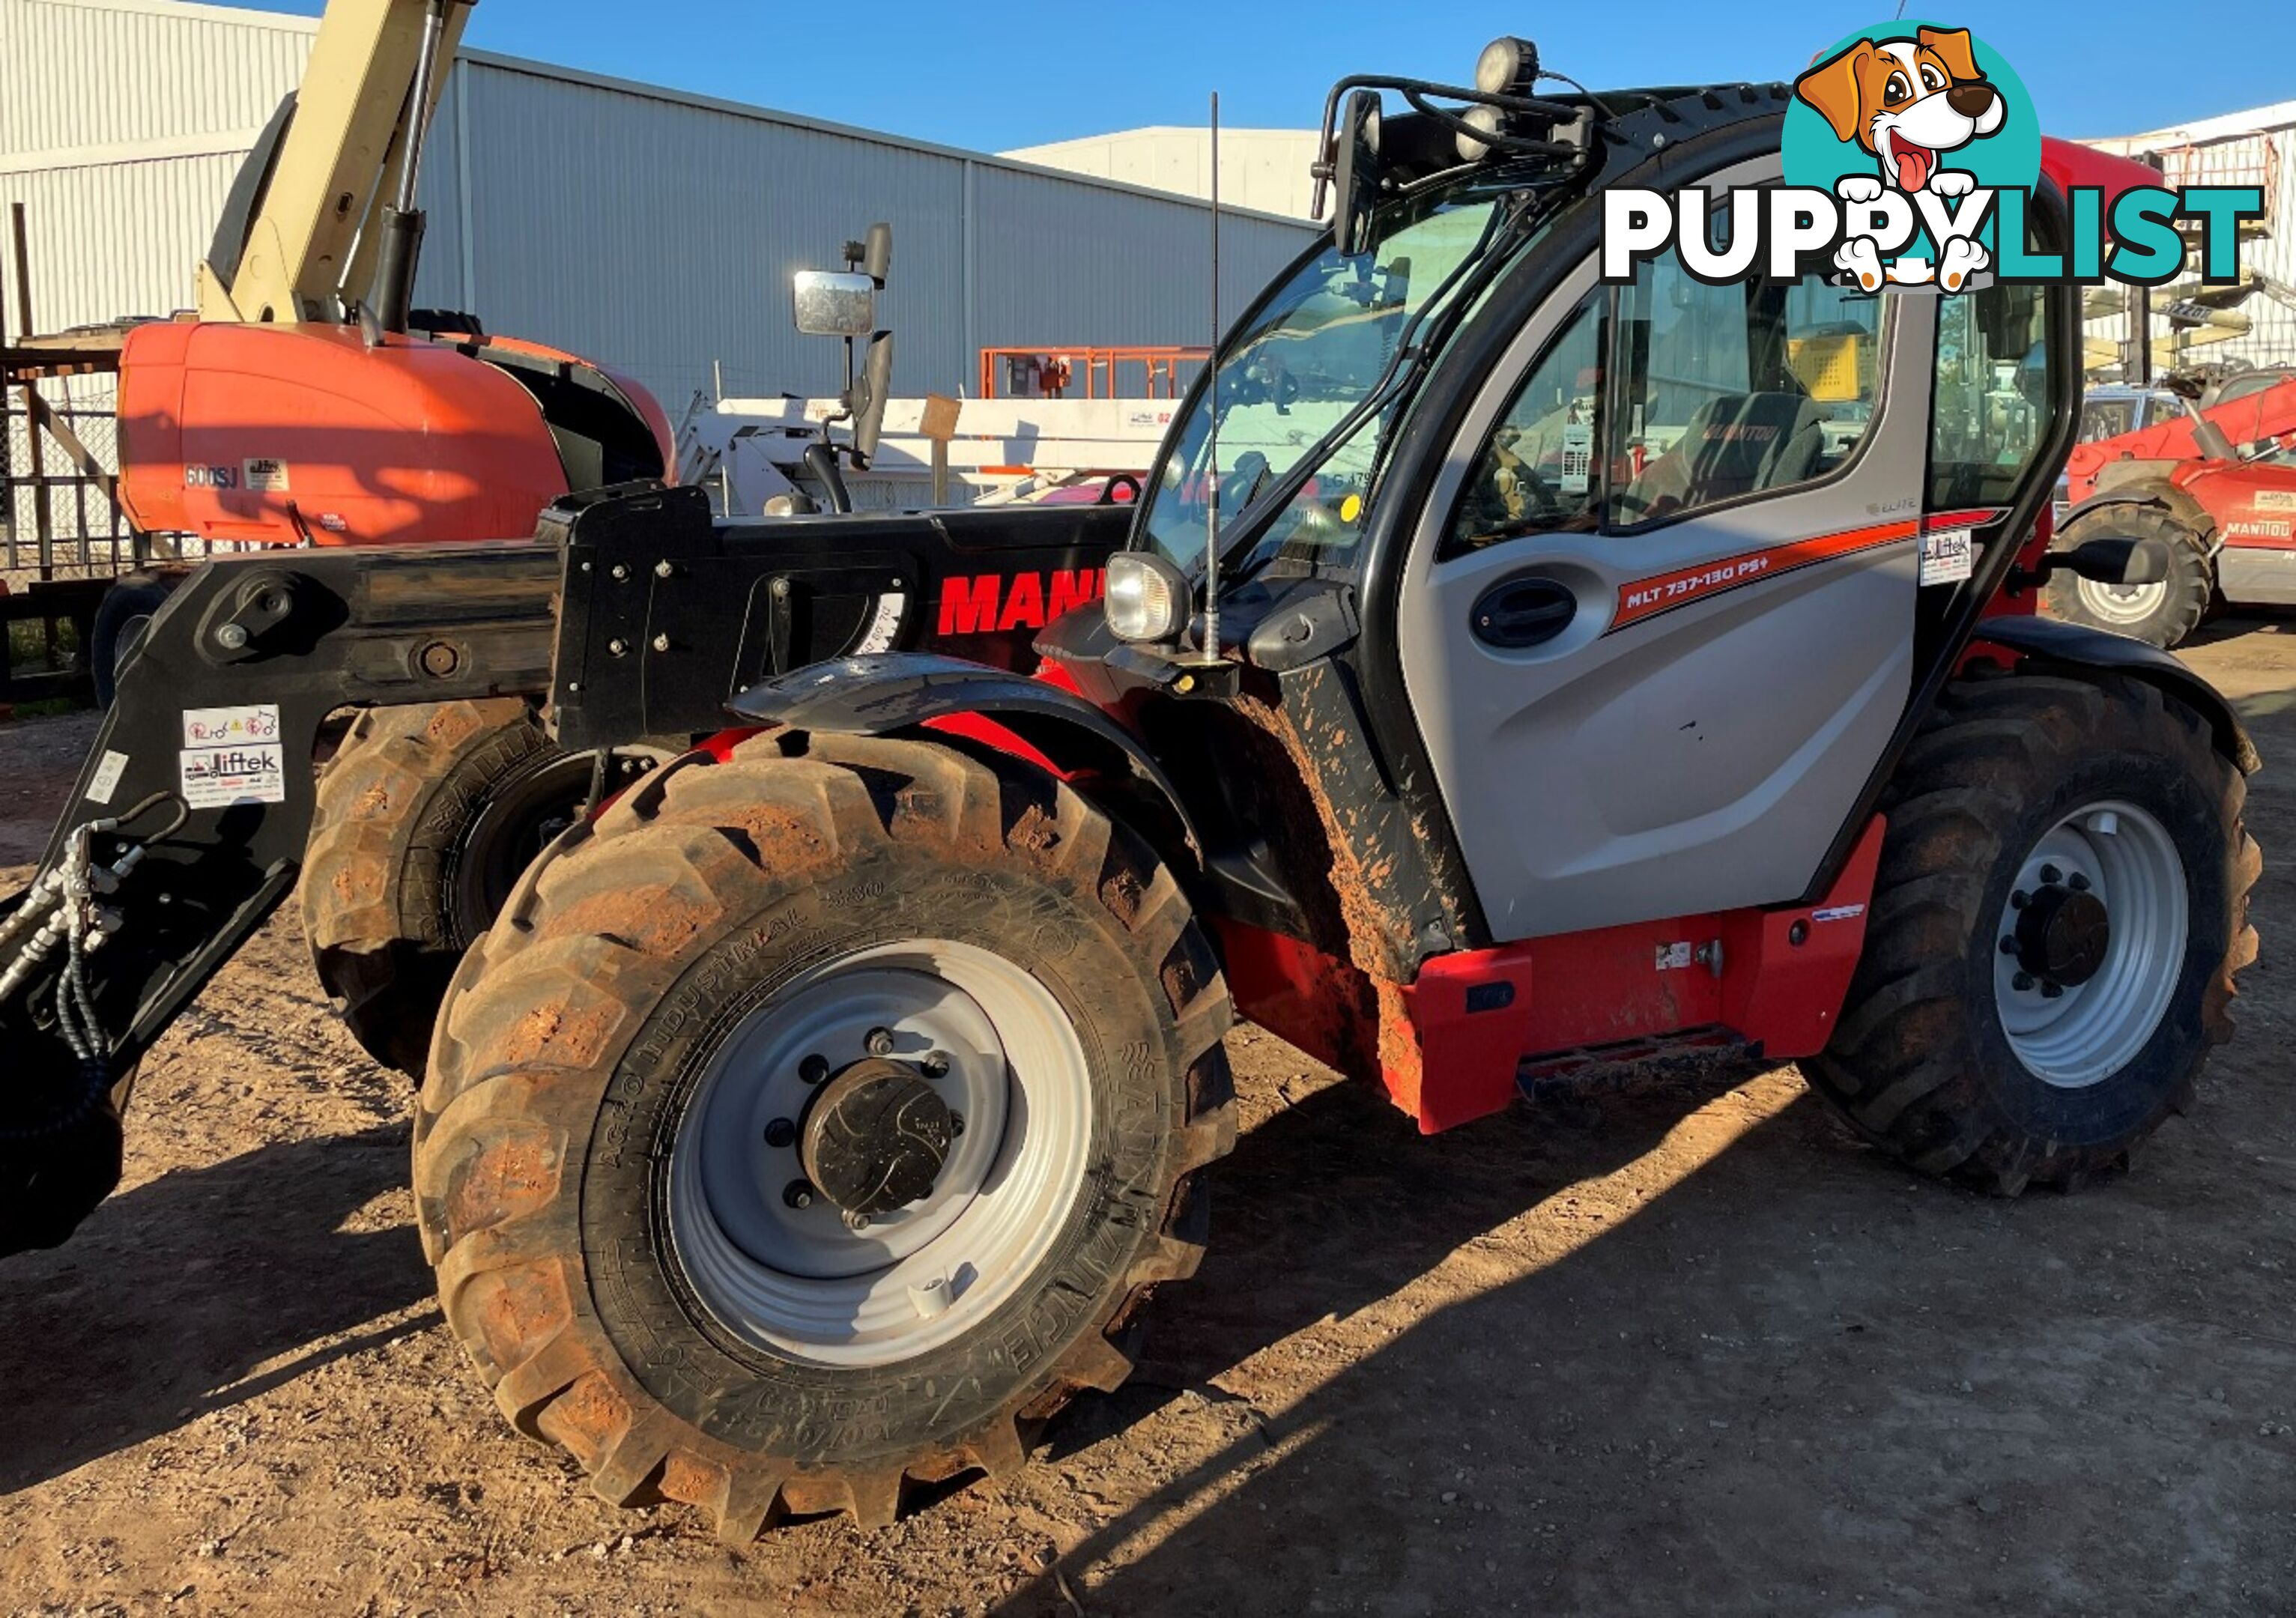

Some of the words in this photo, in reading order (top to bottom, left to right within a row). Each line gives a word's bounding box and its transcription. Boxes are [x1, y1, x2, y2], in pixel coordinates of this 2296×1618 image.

[2227, 520, 2290, 537] MANITOU
[1627, 587, 1662, 608] MLT
[1665, 566, 1734, 597] 737-130
